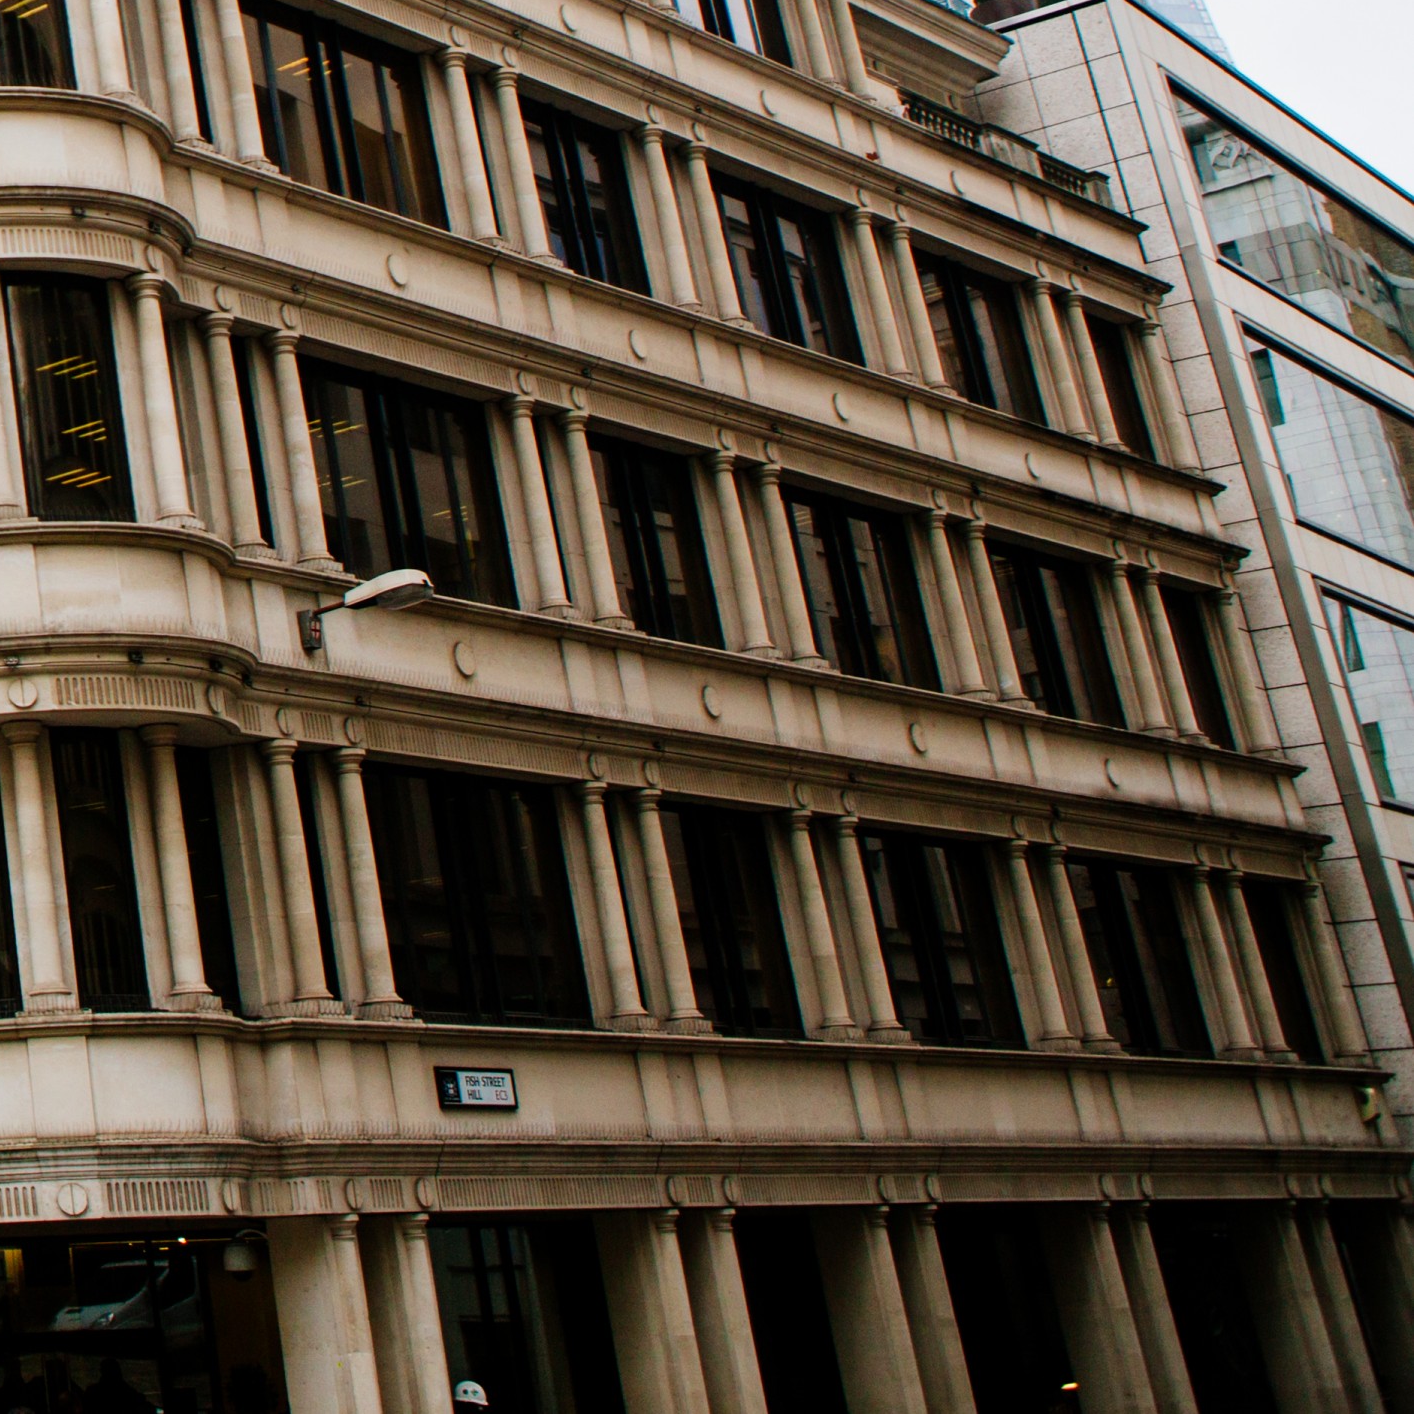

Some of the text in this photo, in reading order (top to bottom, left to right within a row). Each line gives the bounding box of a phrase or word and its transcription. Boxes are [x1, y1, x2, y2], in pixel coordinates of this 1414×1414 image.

[464, 1075, 506, 1087] FISH STREET
[467, 1089, 509, 1101] HILL EC3
